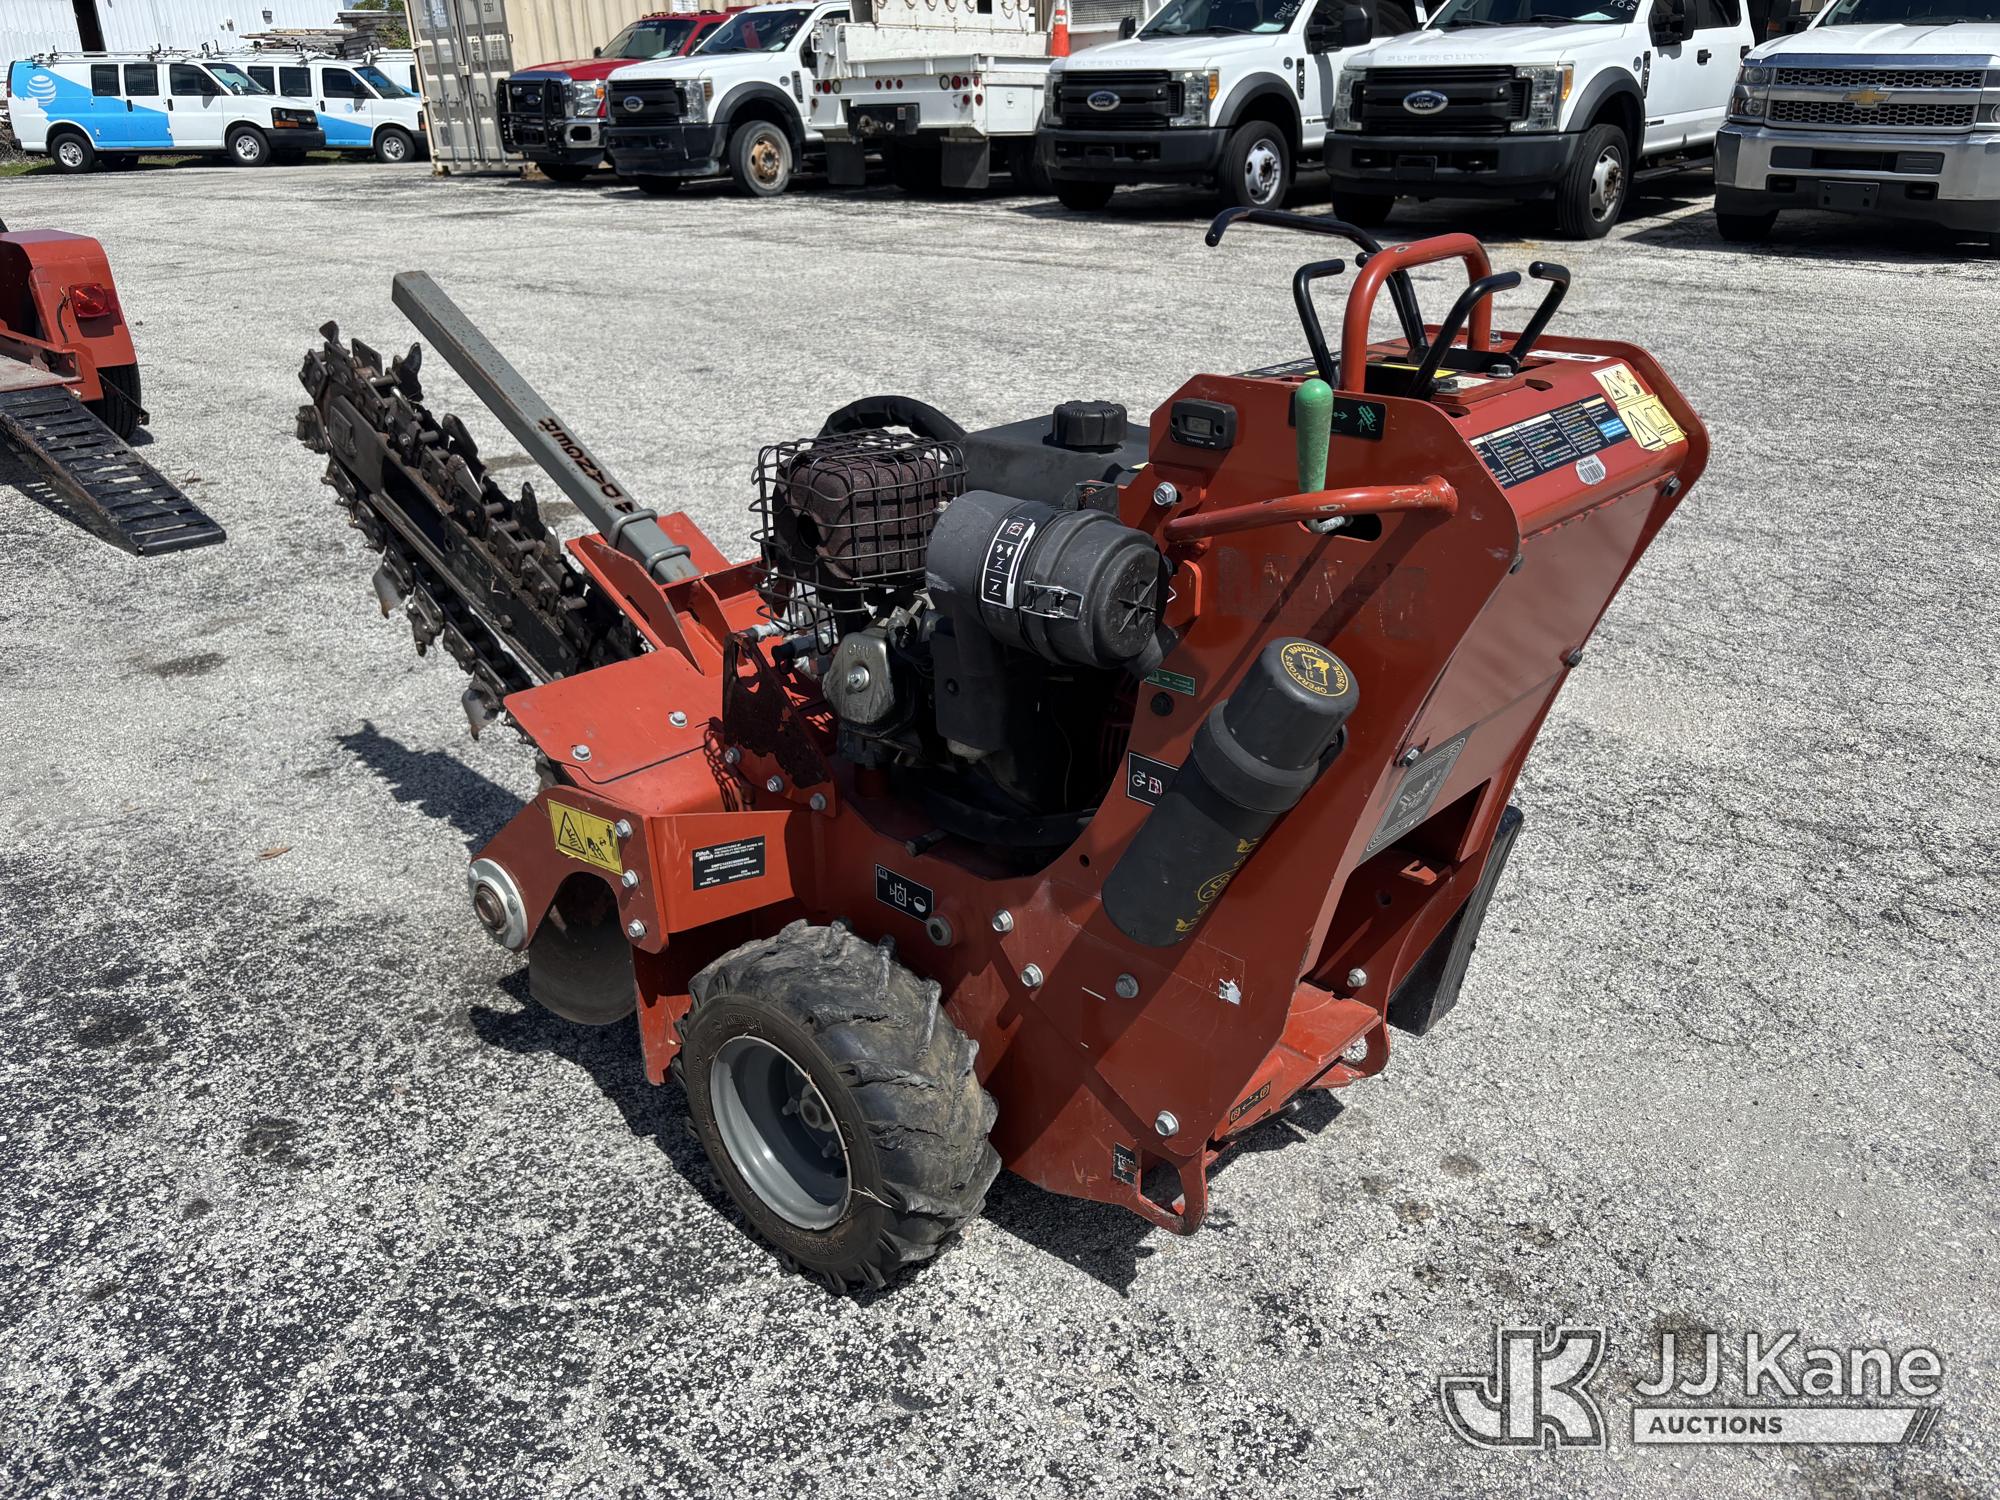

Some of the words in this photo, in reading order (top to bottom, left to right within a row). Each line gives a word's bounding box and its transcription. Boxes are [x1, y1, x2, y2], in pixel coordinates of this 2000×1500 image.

[539, 418, 623, 498] DANGER
[1288, 645, 1320, 656] MANUAL
[1285, 655, 1327, 693] OPERATORS
[1332, 665, 1345, 690] INSIDE
